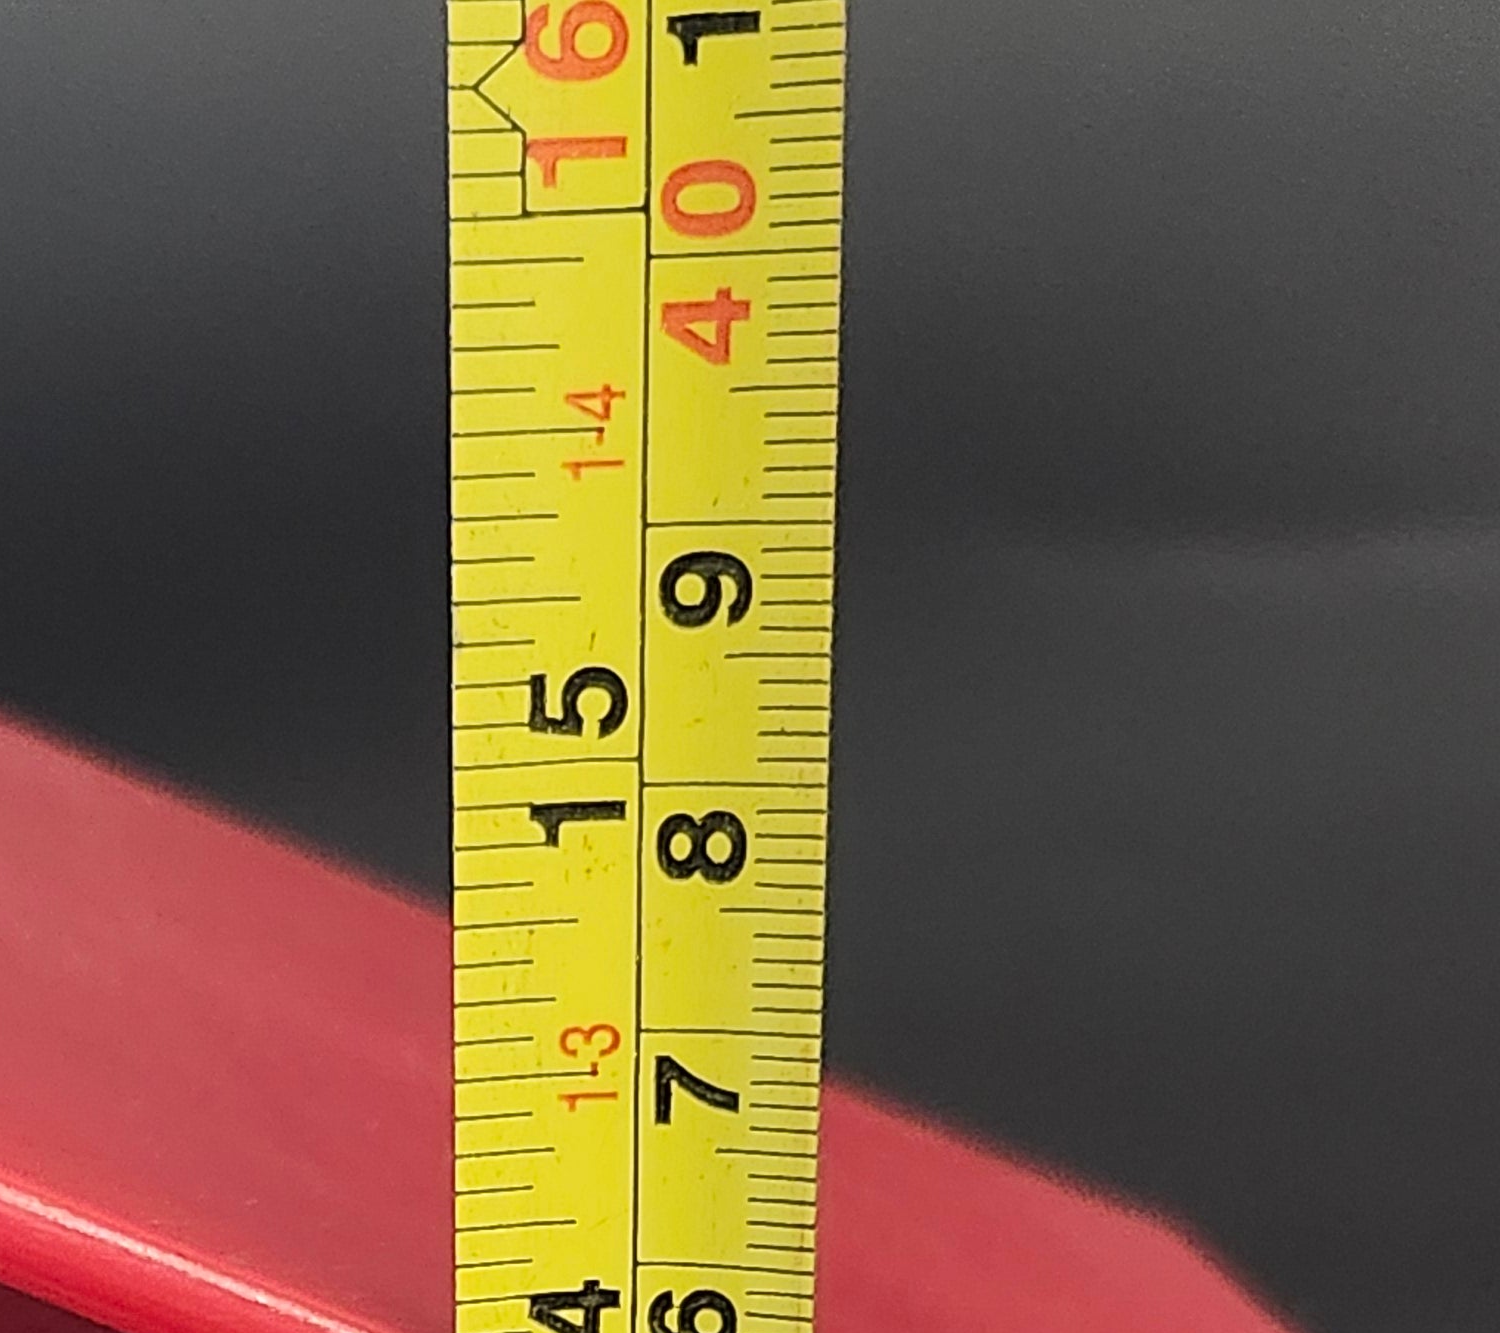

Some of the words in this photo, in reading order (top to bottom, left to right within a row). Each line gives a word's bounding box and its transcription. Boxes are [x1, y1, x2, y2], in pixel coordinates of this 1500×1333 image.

[667, 10, 761, 66] 1
[523, 0, 629, 188] 16
[659, 551, 753, 628] 9
[529, 667, 628, 848] 15
[656, 810, 748, 885] 8
[655, 1055, 739, 1125] 7
